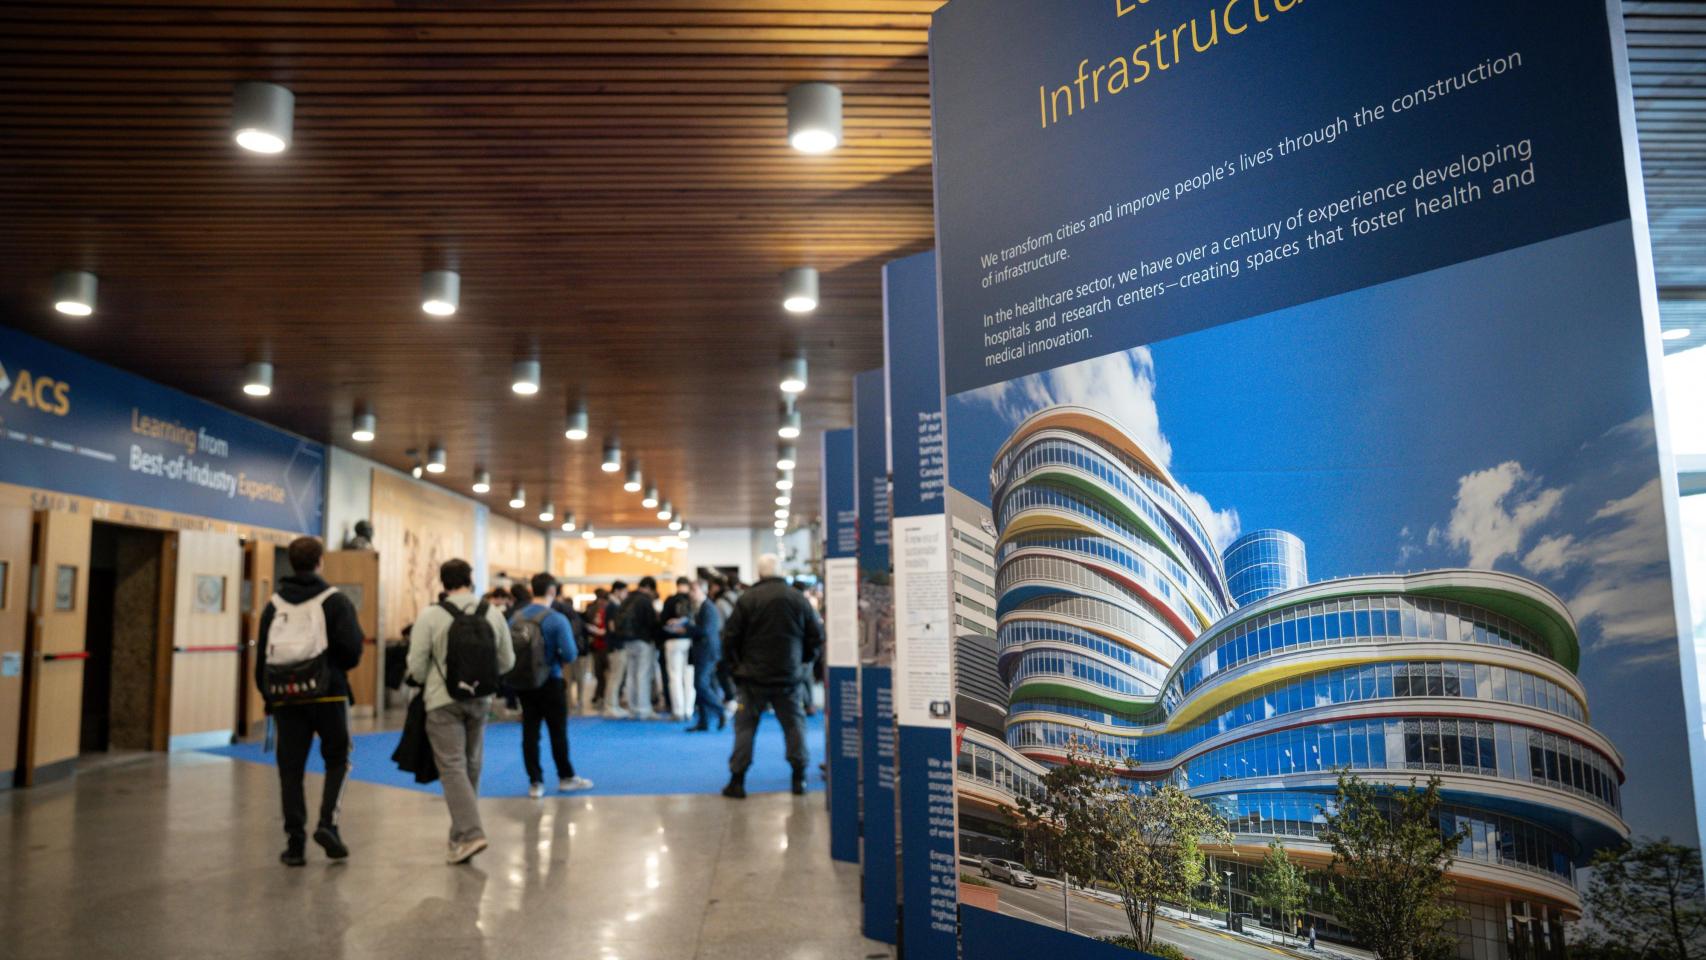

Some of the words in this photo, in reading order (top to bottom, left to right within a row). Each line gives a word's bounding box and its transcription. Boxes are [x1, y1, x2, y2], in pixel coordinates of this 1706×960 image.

[1039, 0, 1301, 128] Infrastruc
[980, 253, 999, 269] We
[1000, 232, 1053, 262] transform
[1056, 221, 1086, 241] cities
[1089, 206, 1113, 228] and
[1116, 187, 1170, 219] improve
[1240, 147, 1274, 171] lives
[1277, 116, 1348, 156] through
[1353, 105, 1385, 128] the
[1391, 52, 1522, 113] construction
[983, 313, 994, 328] In
[995, 308, 1013, 324] the
[1015, 289, 1073, 318] healthcare
[1076, 275, 1116, 298] sector,
[1118, 268, 1138, 285] we
[1141, 256, 1173, 278] have
[1176, 244, 1207, 266] over
[1211, 241, 1220, 255] a
[1223, 221, 1282, 251] century
[1287, 208, 1303, 230] of
[1308, 180, 1407, 223] experience
[1412, 138, 1532, 190] developing
[984, 322, 1031, 347] hospitals
[1035, 311, 1057, 332] and
[1061, 296, 1112, 324] research
[1246, 241, 1300, 271] spaces
[1306, 225, 1344, 250] that
[1351, 207, 1406, 237] foster
[1415, 182, 1482, 218] health
[1492, 162, 1536, 194] and
[981, 272, 994, 289] of
[995, 248, 1071, 284] infrastructure.
[985, 344, 1026, 367] medical
[1028, 327, 1093, 355] innovation.
[11, 370, 70, 416] ACS
[131, 408, 197, 455] Learning
[199, 426, 229, 458] from
[129, 444, 238, 498] Best-of-Industry
